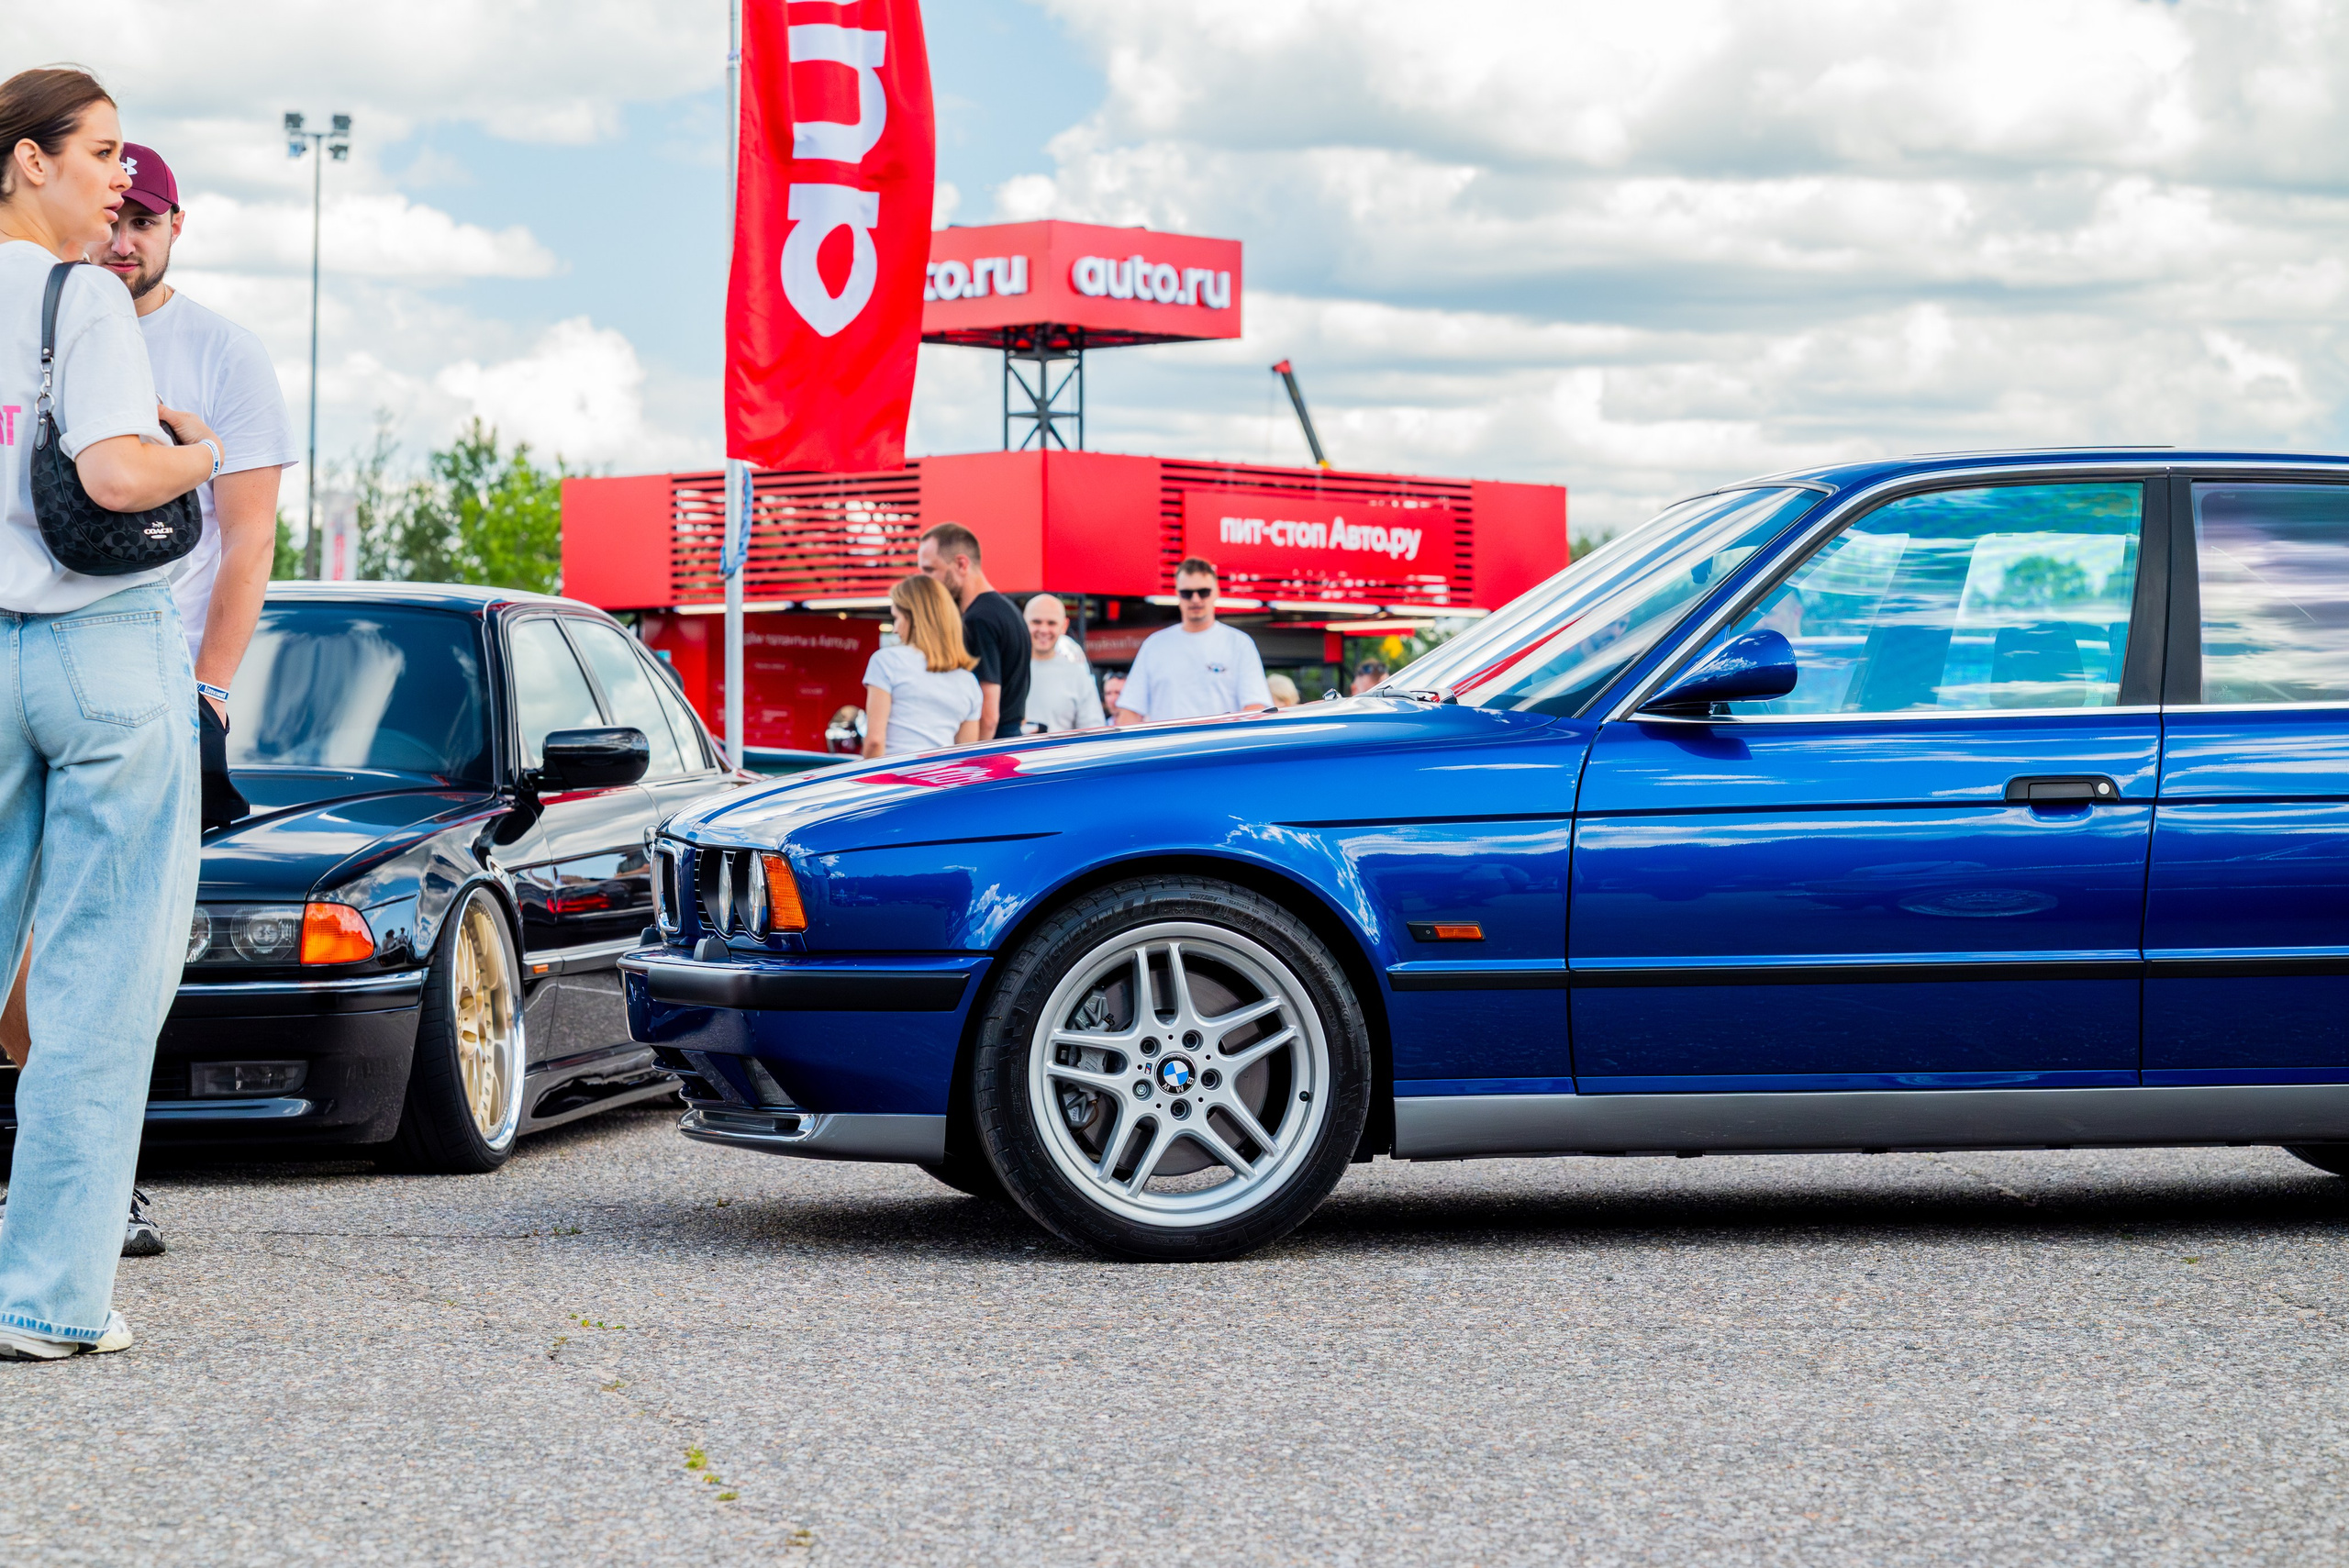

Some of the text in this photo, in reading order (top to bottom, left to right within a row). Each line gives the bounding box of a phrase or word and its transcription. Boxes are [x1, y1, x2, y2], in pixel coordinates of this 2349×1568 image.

[1071, 254, 1231, 309] auto.ru
[1219, 516, 1423, 562] пит-стоп Авто.ру
[1162, 1076, 1194, 1093] BMW
